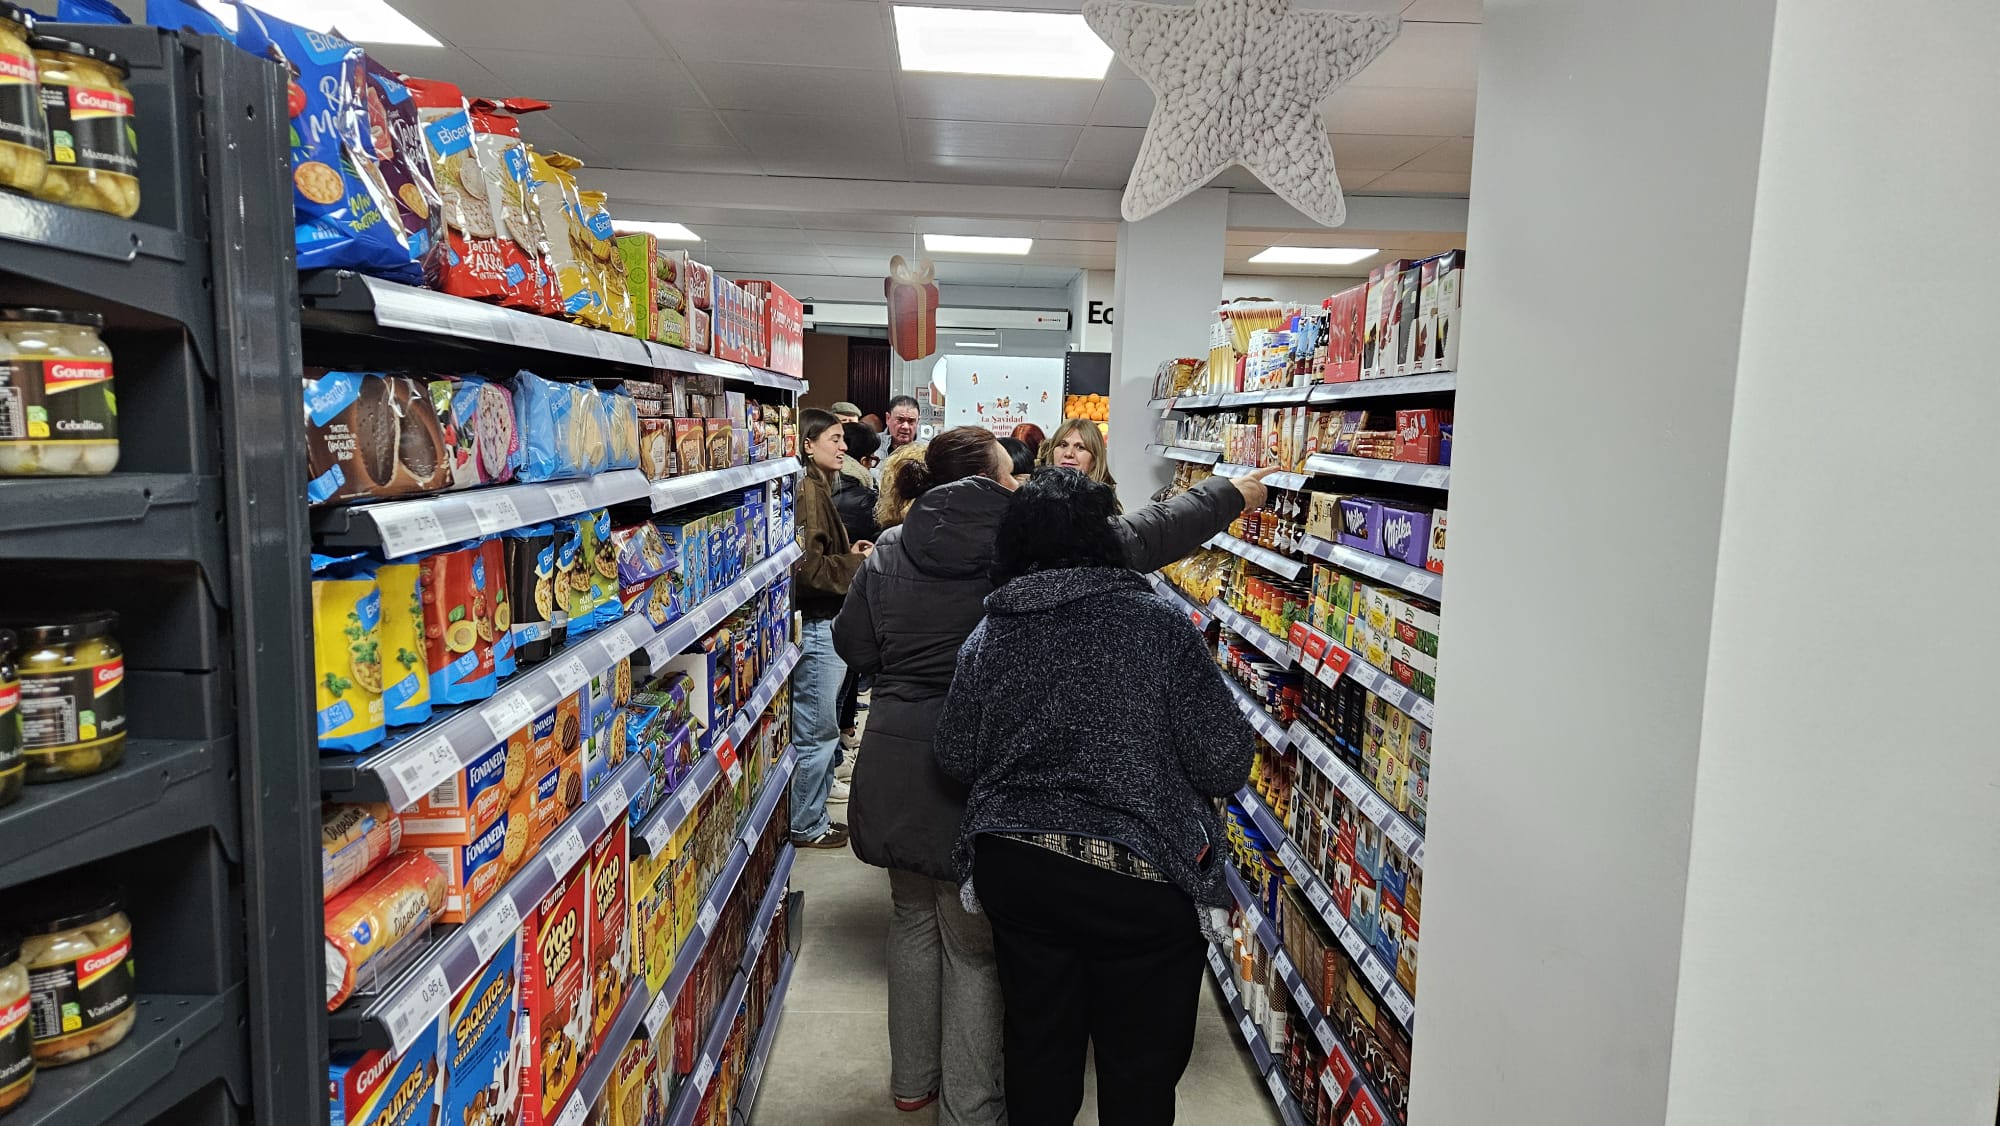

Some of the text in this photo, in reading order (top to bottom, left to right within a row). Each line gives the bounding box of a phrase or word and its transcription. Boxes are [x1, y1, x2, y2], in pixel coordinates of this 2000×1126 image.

[76, 92, 127, 113] Gourmet
[475, 253, 506, 273] ARRO
[51, 365, 105, 379] Gourmet
[56, 419, 104, 431] Cebollitas
[991, 415, 1023, 423] Navidad
[1346, 507, 1365, 534] Milka
[1384, 515, 1411, 550] Milka
[626, 582, 645, 595] Gourmet
[533, 712, 555, 735] ONTANEDA
[469, 746, 506, 788] FONTANEDA
[538, 772, 558, 794] NTANEDA
[477, 788, 500, 815] Digestive
[324, 806, 364, 842] Digestive
[465, 821, 507, 866] FONTANEDA
[595, 828, 613, 857] Gourmet
[473, 862, 498, 892] Digestive
[596, 854, 620, 902] CHOCO
[540, 879, 566, 916] Gourmet
[598, 882, 616, 921] FLAKES
[394, 893, 426, 937] Digestive
[543, 907, 577, 968] CHOCO
[84, 944, 129, 972] Gourmet
[545, 941, 571, 988] FLAKES
[87, 993, 129, 1018] Variantes
[456, 969, 505, 1048] SAQUITOS
[453, 1022, 486, 1069] RELLENOS
[356, 1050, 393, 1094] Gourm
